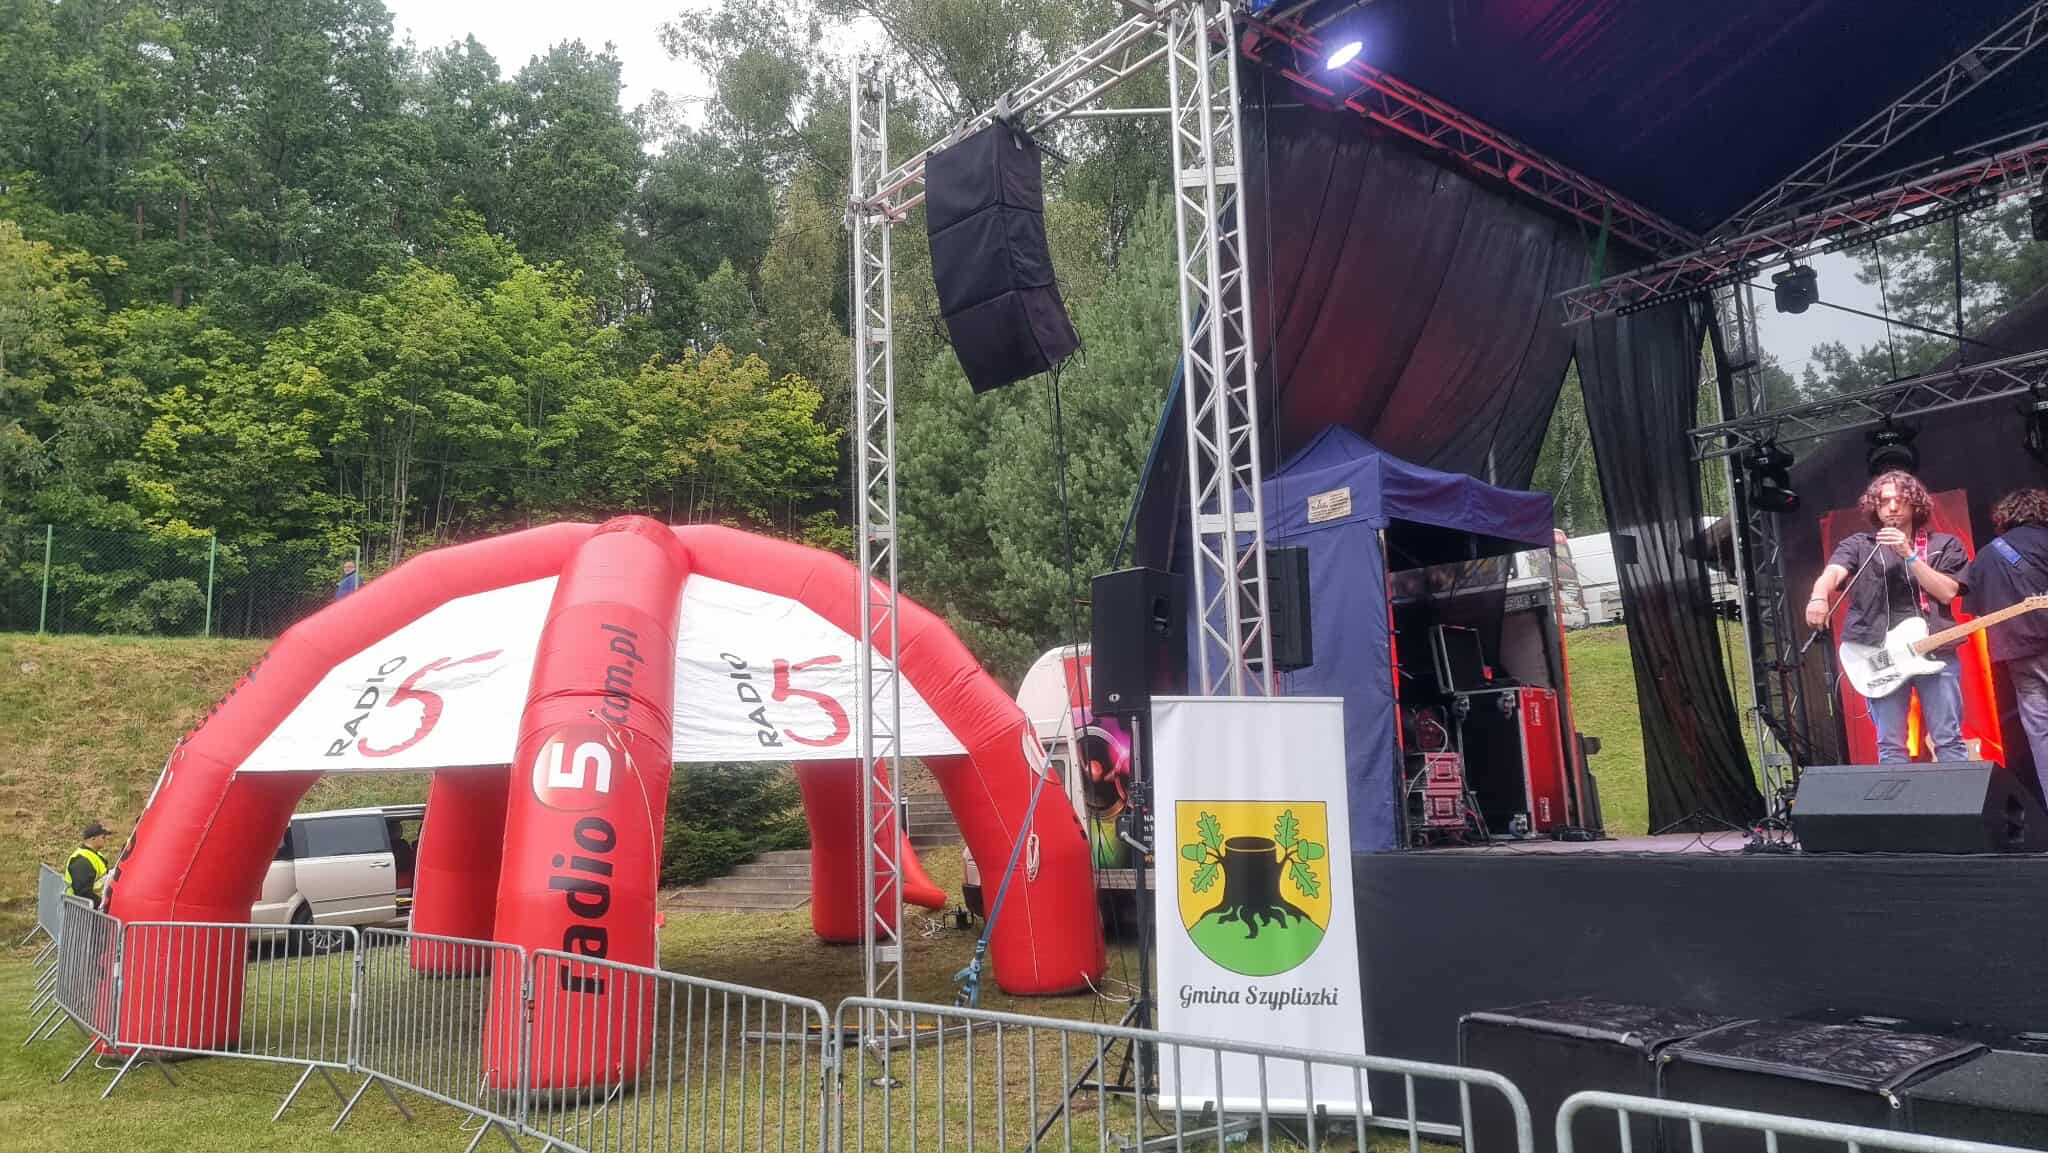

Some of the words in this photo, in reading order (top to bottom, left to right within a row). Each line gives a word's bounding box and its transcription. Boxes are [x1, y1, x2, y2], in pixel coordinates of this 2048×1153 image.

[324, 656, 407, 756] RADIO
[357, 649, 504, 757] 5
[720, 653, 783, 747] RADIO
[771, 655, 850, 747] 5
[547, 741, 612, 793] 5
[548, 816, 617, 995] radio
[1180, 984, 1240, 1008] Gmina
[1246, 985, 1339, 1012] Szypliszki
